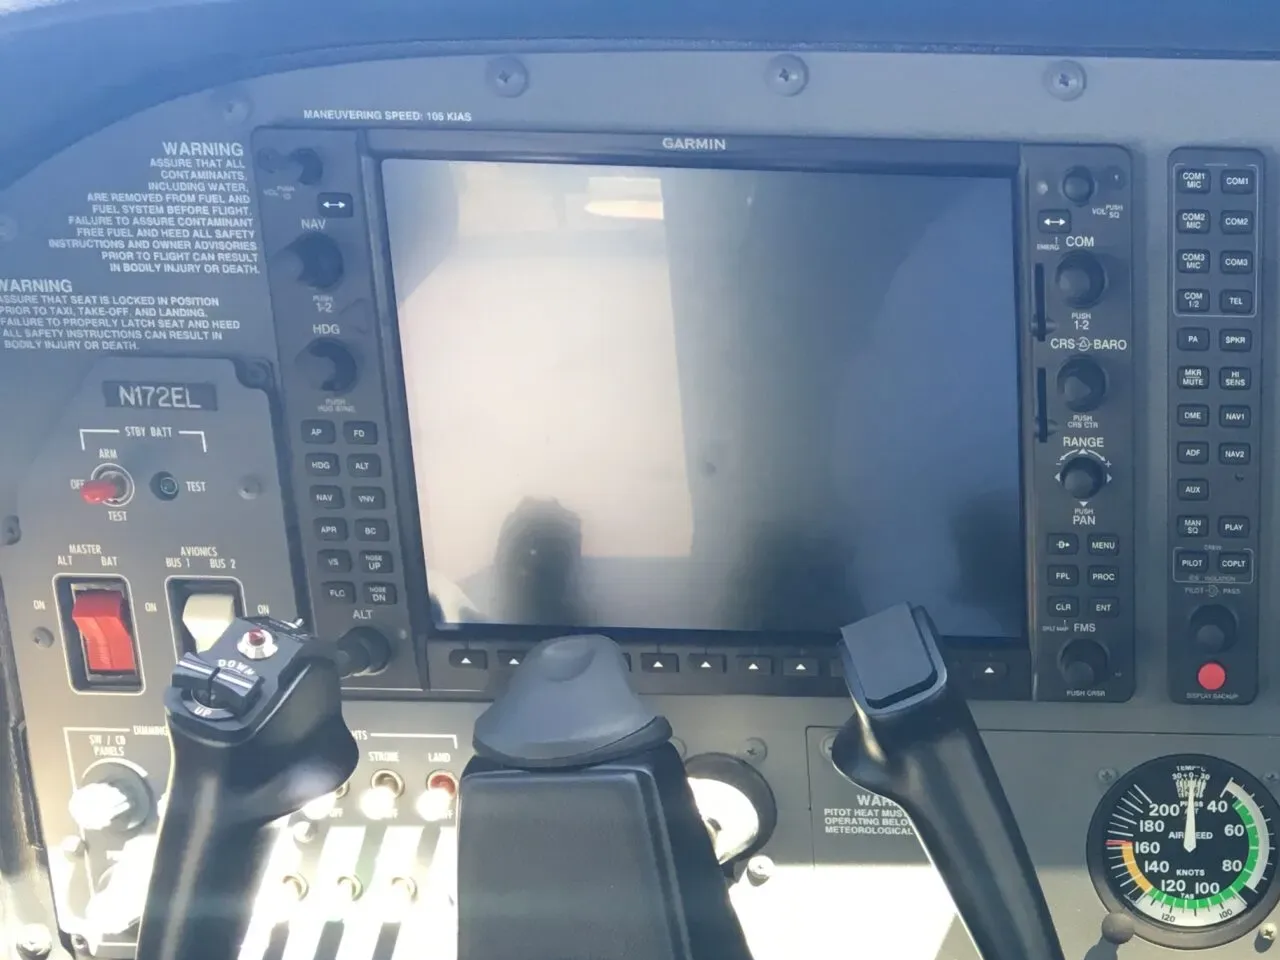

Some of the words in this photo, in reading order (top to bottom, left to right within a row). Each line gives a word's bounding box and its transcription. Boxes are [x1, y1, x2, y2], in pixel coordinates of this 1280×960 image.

[304, 110, 382, 120] MANEUVERING
[447, 112, 472, 121] KIAS
[162, 142, 244, 156] WARNING
[662, 138, 726, 150] GARMIN
[150, 158, 192, 167] ASSURE
[196, 159, 221, 168] THAT
[226, 159, 245, 168] ALL
[1226, 177, 1249, 185] COM1
[149, 182, 205, 191] INCLUDING
[302, 220, 325, 230] NAV
[1225, 218, 1248, 226] COM2
[1066, 236, 1094, 247] COM
[1225, 258, 1248, 266] COM3
[110, 264, 120, 272] IN
[124, 264, 161, 272] BODILY
[164, 264, 200, 273] INJURY
[204, 265, 219, 273] OR
[1, 318, 44, 326] FAILURE
[48, 318, 60, 326] TO
[63, 318, 117, 327] PROPERLY
[121, 319, 155, 327] LATCH
[158, 319, 184, 328] SEAT
[188, 320, 209, 328] AND
[212, 320, 240, 329] HEED
[1074, 320, 1089, 330] 1-2
[313, 324, 340, 335] HDG
[1051, 338, 1075, 349] CRS
[1094, 339, 1127, 350] BARO
[1226, 336, 1246, 344] SPKR
[119, 386, 201, 408] N172EL
[125, 427, 145, 437] STBY
[151, 427, 172, 437] BATT
[1063, 437, 1104, 448] RANGE
[99, 449, 118, 458] ARM
[1225, 450, 1244, 458] NAV2
[186, 482, 206, 492] TEST
[1185, 486, 1201, 494] AUX
[108, 512, 127, 521] TEST
[1072, 516, 1096, 525] PAN
[1225, 523, 1243, 532] PLAY
[69, 545, 101, 554] MASTER
[181, 547, 217, 556] AVIONICS
[57, 556, 72, 565] ALT
[101, 556, 117, 566] BAT
[166, 558, 182, 568] BUS
[186, 558, 190, 567] 1
[210, 559, 226, 568] BUS
[231, 559, 236, 568] 2
[1182, 559, 1202, 567] PILOT
[1222, 560, 1246, 568] COPLT
[1056, 572, 1070, 580] FPL
[1093, 573, 1115, 581] PROC
[34, 600, 45, 609] ON
[145, 602, 157, 612] ON
[1096, 604, 1111, 612] ENT
[353, 610, 373, 620] ALT
[1074, 624, 1096, 632] FMS
[1149, 804, 1179, 816] 200
[1207, 800, 1228, 813] 40
[854, 809, 879, 817] HEAT
[825, 818, 880, 826] OPERATING
[1140, 820, 1164, 832] 180
[825, 826, 913, 835] METEOROLOGICAL
[1224, 824, 1244, 837] 60
[1135, 842, 1160, 854] 160
[1145, 861, 1169, 873] 140
[1222, 860, 1242, 872] 80
[1161, 880, 1186, 892] 120
[1195, 882, 1220, 894] 100
